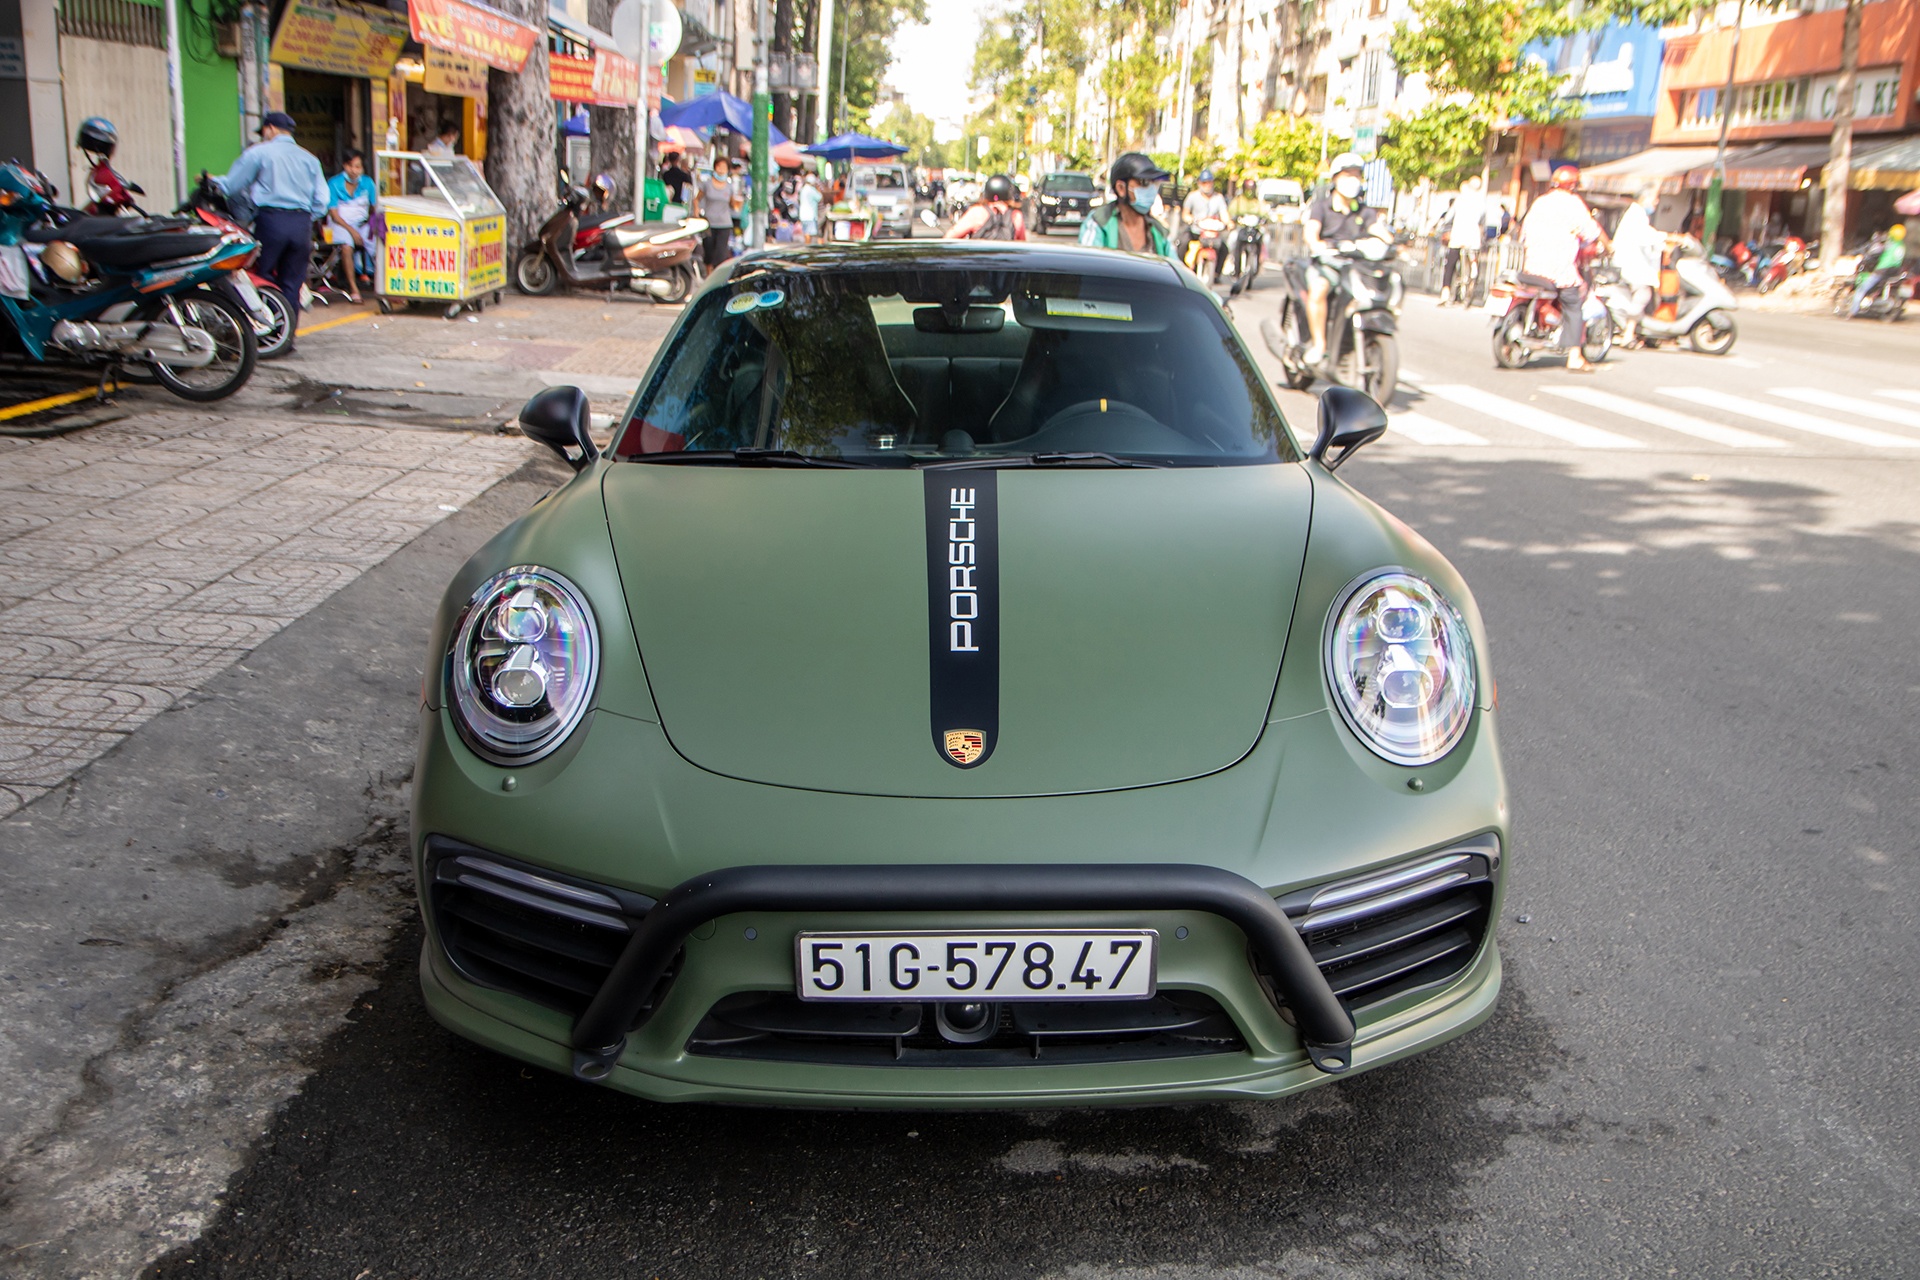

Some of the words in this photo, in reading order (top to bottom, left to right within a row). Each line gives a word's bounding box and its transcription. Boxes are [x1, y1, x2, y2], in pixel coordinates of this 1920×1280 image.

[411, 247, 456, 272] THANH
[949, 487, 980, 652] PORSCHE
[811, 940, 1143, 992] 51G-578.47
